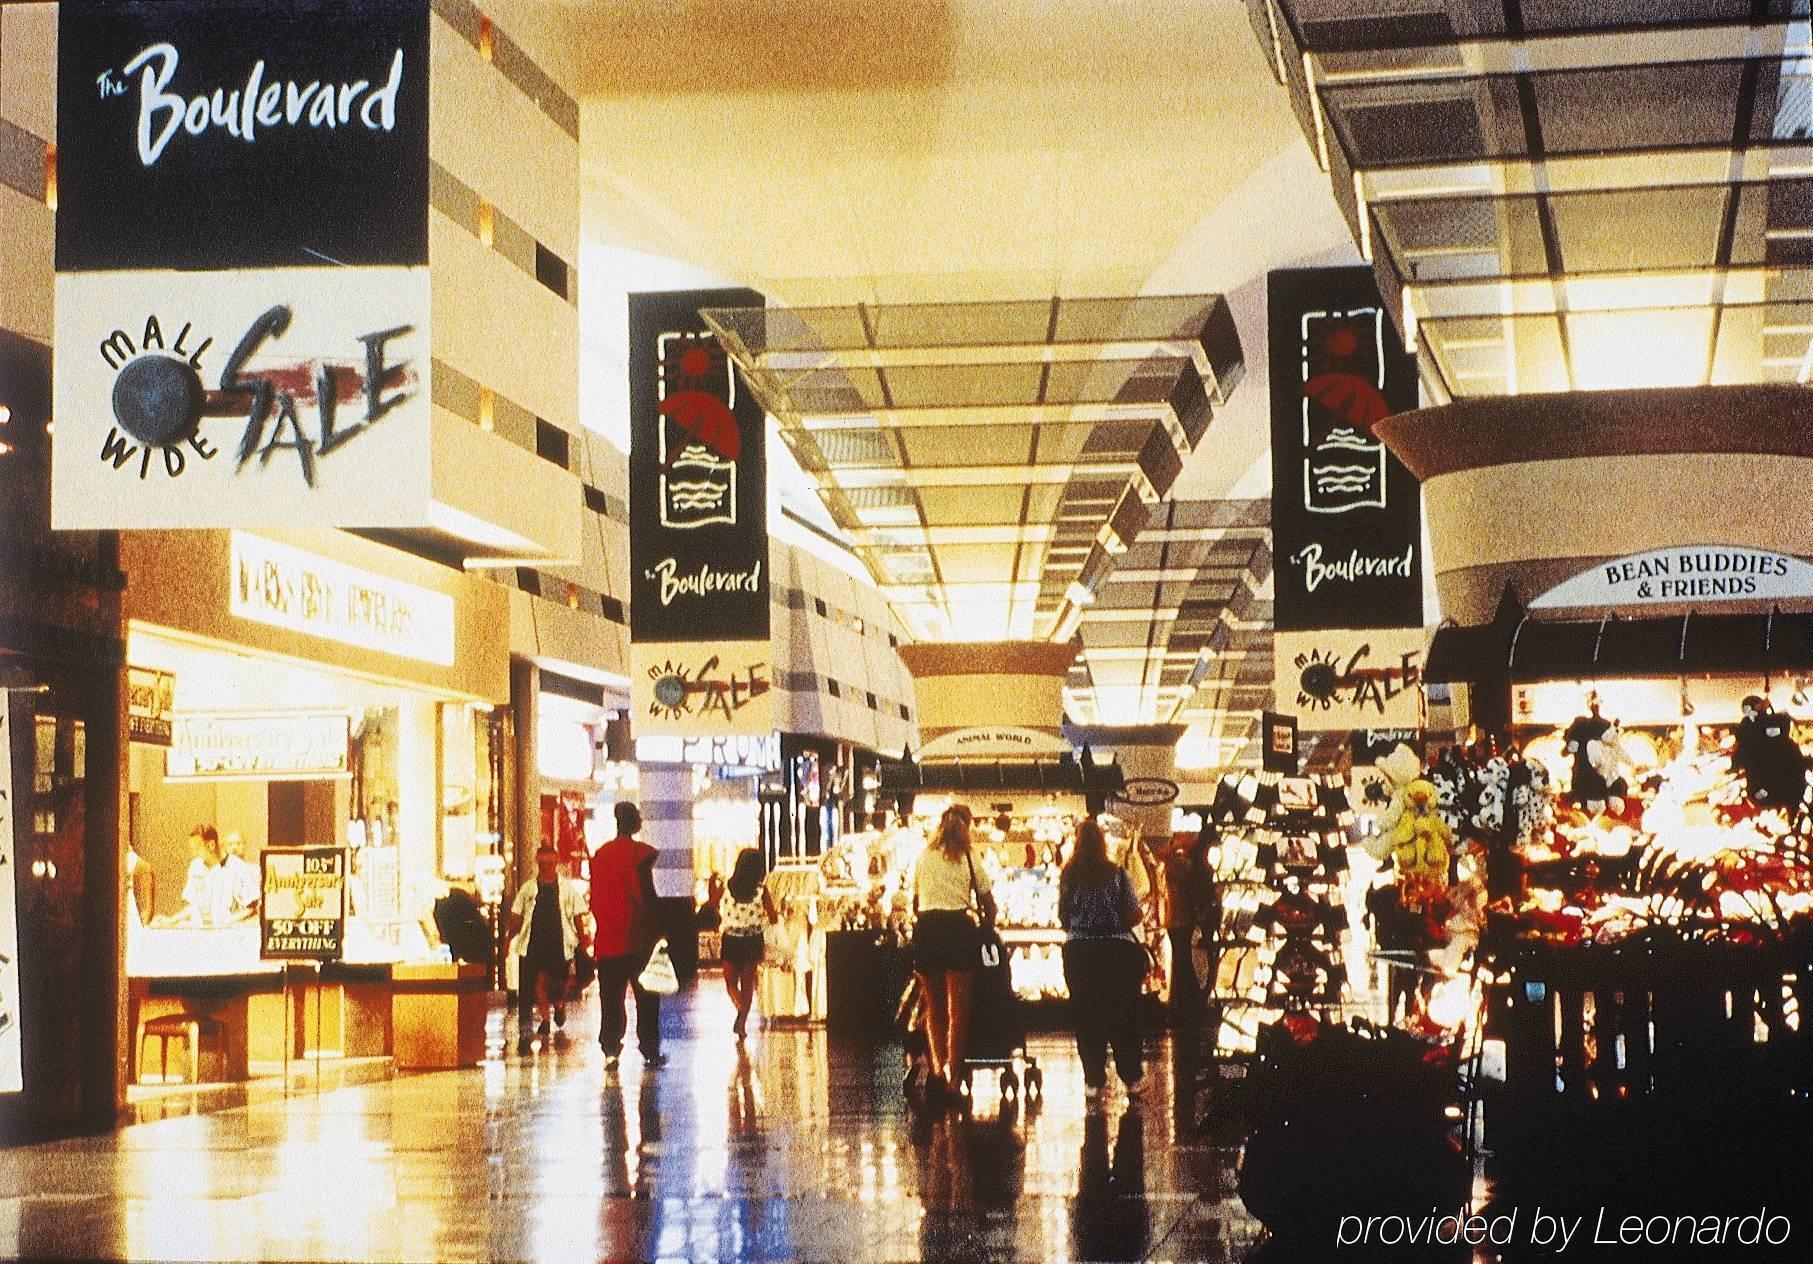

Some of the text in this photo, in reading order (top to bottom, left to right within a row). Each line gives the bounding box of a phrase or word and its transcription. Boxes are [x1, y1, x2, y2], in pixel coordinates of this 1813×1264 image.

[97, 43, 403, 165] The Boulevard
[101, 315, 213, 370] MALL
[220, 304, 418, 488] SALE
[101, 427, 218, 479] WIDE
[655, 558, 760, 605] Boulevard
[1300, 542, 1413, 592] Boulevard
[1606, 554, 1788, 584] BEAN BUDDIES
[1637, 576, 1756, 598] & FRIENDS
[648, 659, 691, 681] MALL
[1294, 648, 1341, 669] MALL
[697, 655, 769, 721] SALE
[1344, 643, 1420, 714] SALE
[649, 702, 693, 720] WIDE
[957, 733, 1032, 744] ANIMAL WORLD
[267, 937, 337, 950] EVERYTHING
[299, 919, 335, 935] OFF
